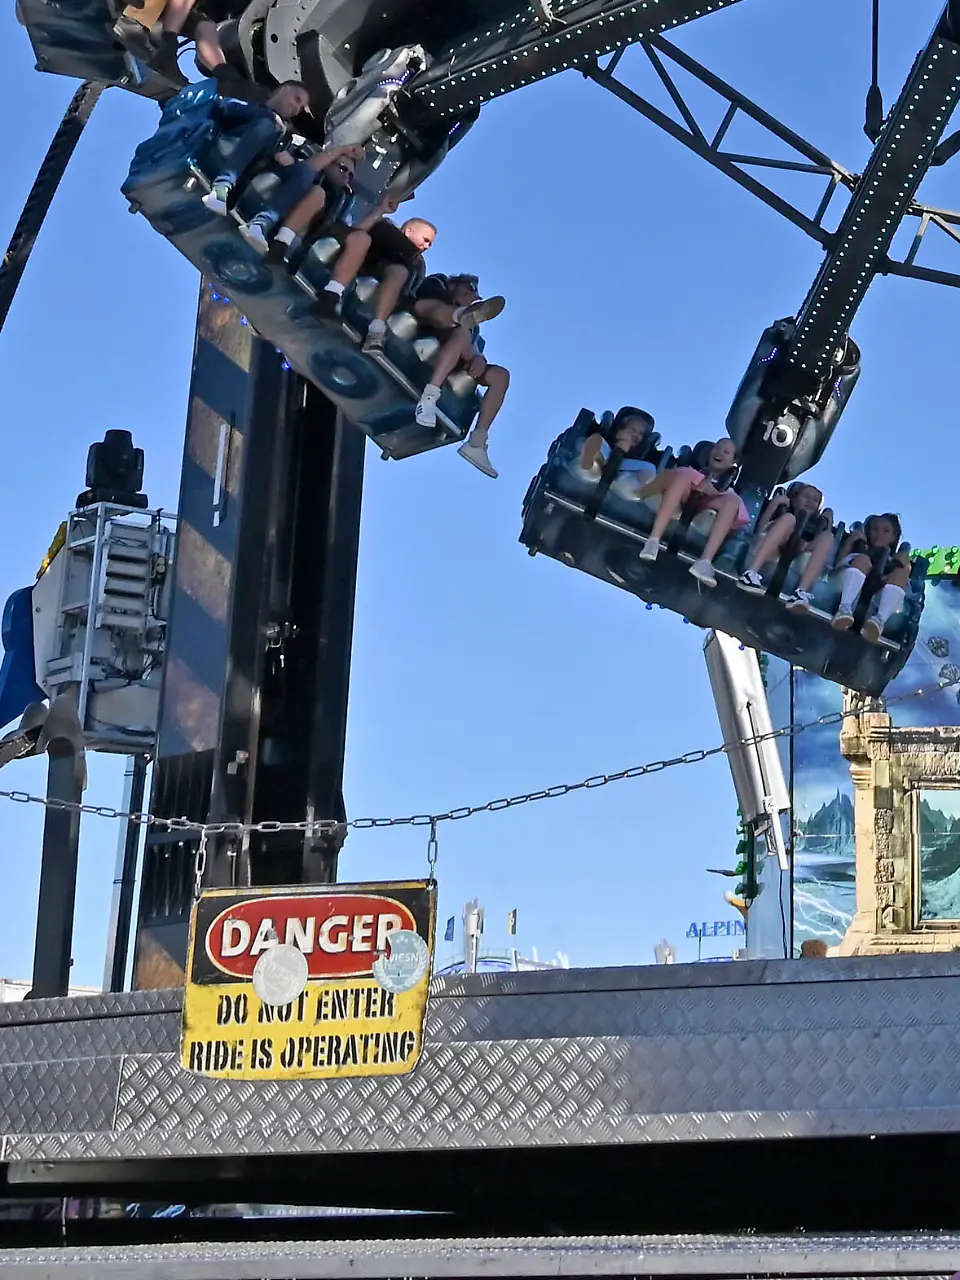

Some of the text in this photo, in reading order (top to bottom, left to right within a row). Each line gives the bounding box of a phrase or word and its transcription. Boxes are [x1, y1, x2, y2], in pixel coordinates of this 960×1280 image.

[762, 420, 794, 448] 10
[220, 912, 404, 957] DANGER
[216, 986, 397, 1025] DO NOT ENTER
[188, 1029, 416, 1072] RIDE IS OPERATING
